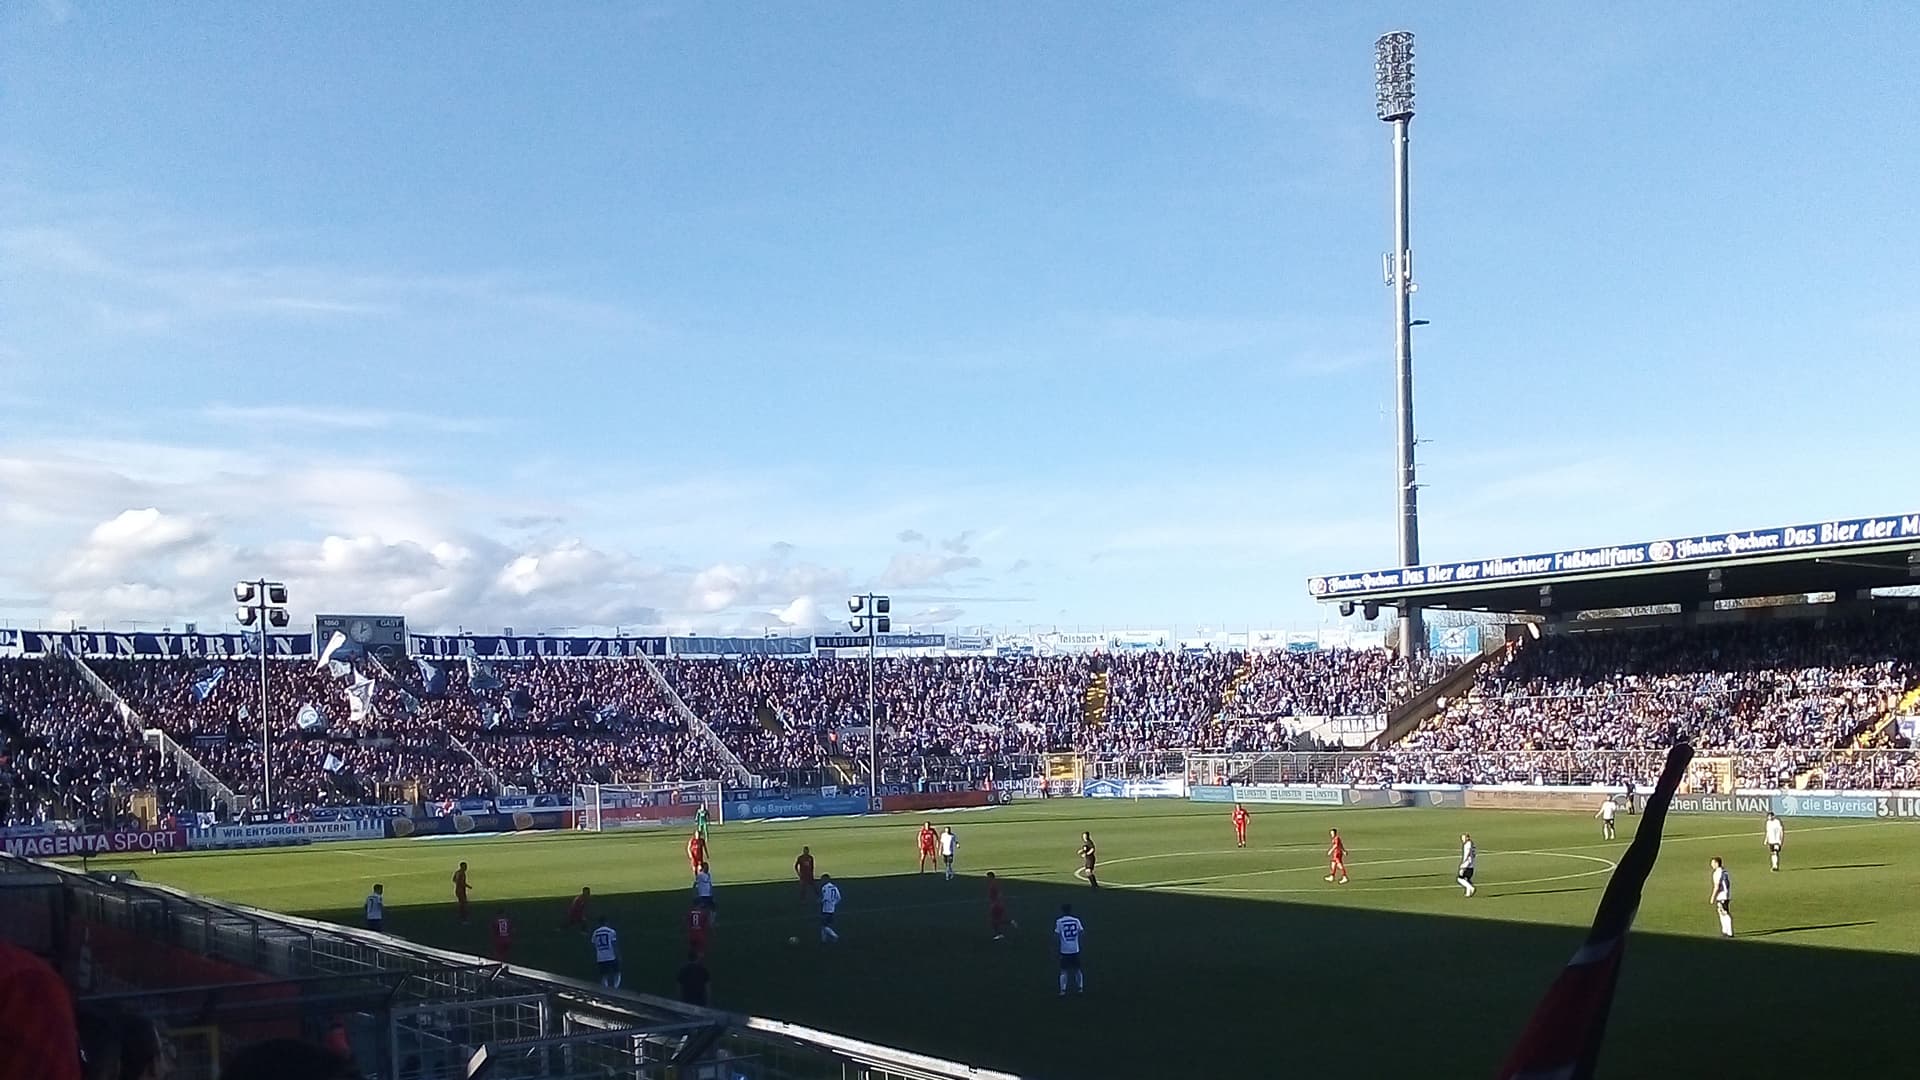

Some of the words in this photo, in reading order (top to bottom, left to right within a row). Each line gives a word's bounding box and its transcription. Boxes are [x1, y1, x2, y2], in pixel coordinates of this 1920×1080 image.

[1784, 527, 1815, 546] Das
[1820, 522, 1861, 544] Bier
[1862, 518, 1896, 538] der
[1402, 569, 1424, 585] Das
[1427, 565, 1453, 582] Bier
[1456, 563, 1479, 580] der
[1482, 554, 1551, 577] Münchner
[1554, 546, 1645, 570] Fußballfans
[37, 633, 136, 655] MEIN
[155, 634, 295, 656] VEREN
[411, 635, 476, 657] FÜR
[494, 638, 572, 657] ALLE
[587, 638, 658, 657] ZEIT
[1702, 796, 1733, 811] fährt
[1735, 797, 1770, 812] MAN
[1802, 797, 1820, 811] die
[1878, 798, 1895, 816] 3.
[222, 828, 243, 838] WIR
[245, 826, 306, 837] ENTSORGEN
[307, 823, 351, 834] BAYERN!
[5, 834, 111, 856] MAGENTA
[114, 831, 177, 850] SPORT
[1063, 923, 1077, 938] 22
